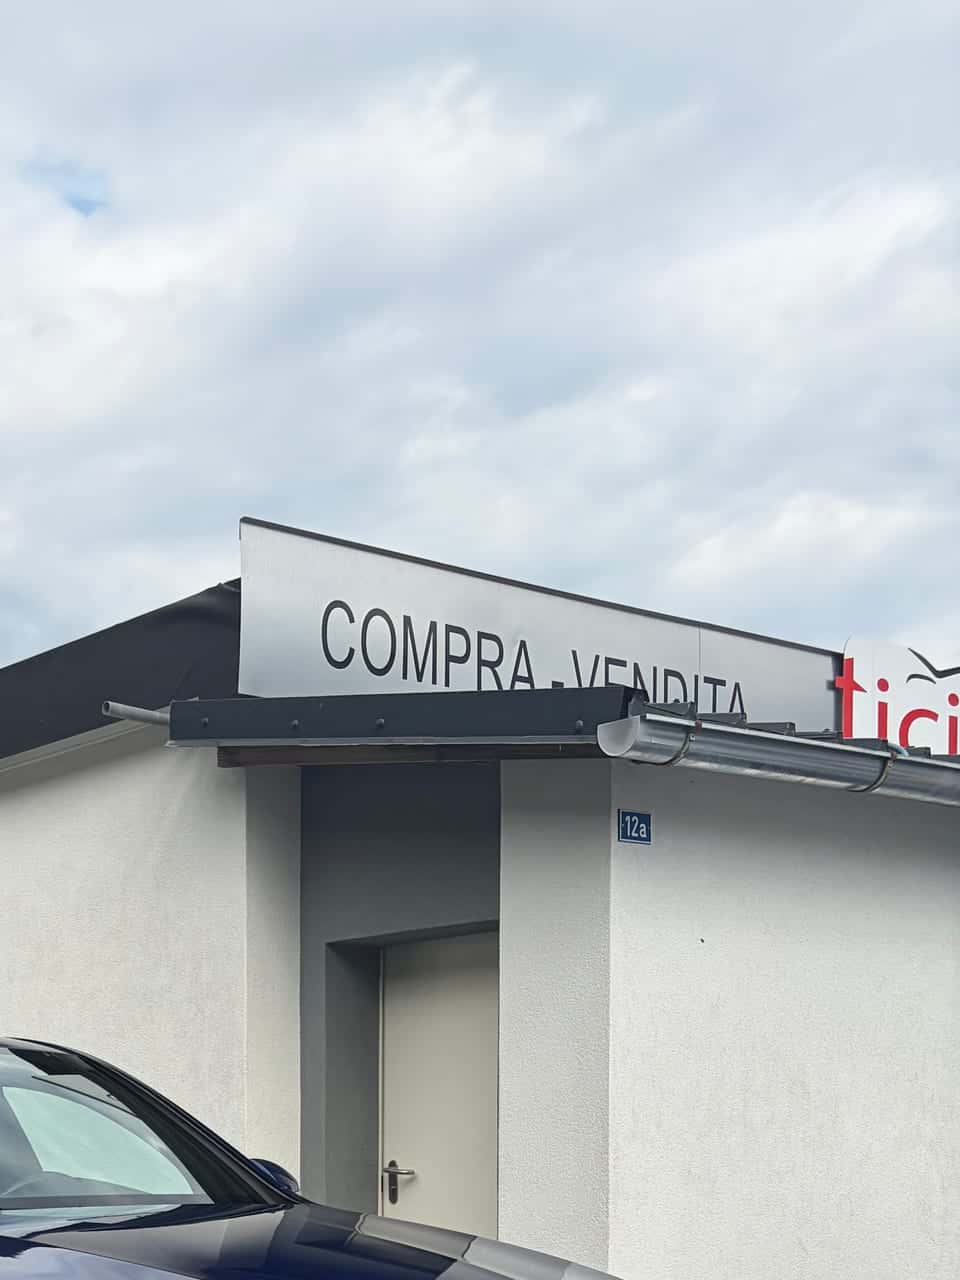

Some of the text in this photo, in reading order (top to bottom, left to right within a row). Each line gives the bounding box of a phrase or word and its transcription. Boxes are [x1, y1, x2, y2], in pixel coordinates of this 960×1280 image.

[321, 600, 536, 691] COMPRA
[571, 650, 746, 713] VENDITA
[625, 815, 648, 838] 12a
